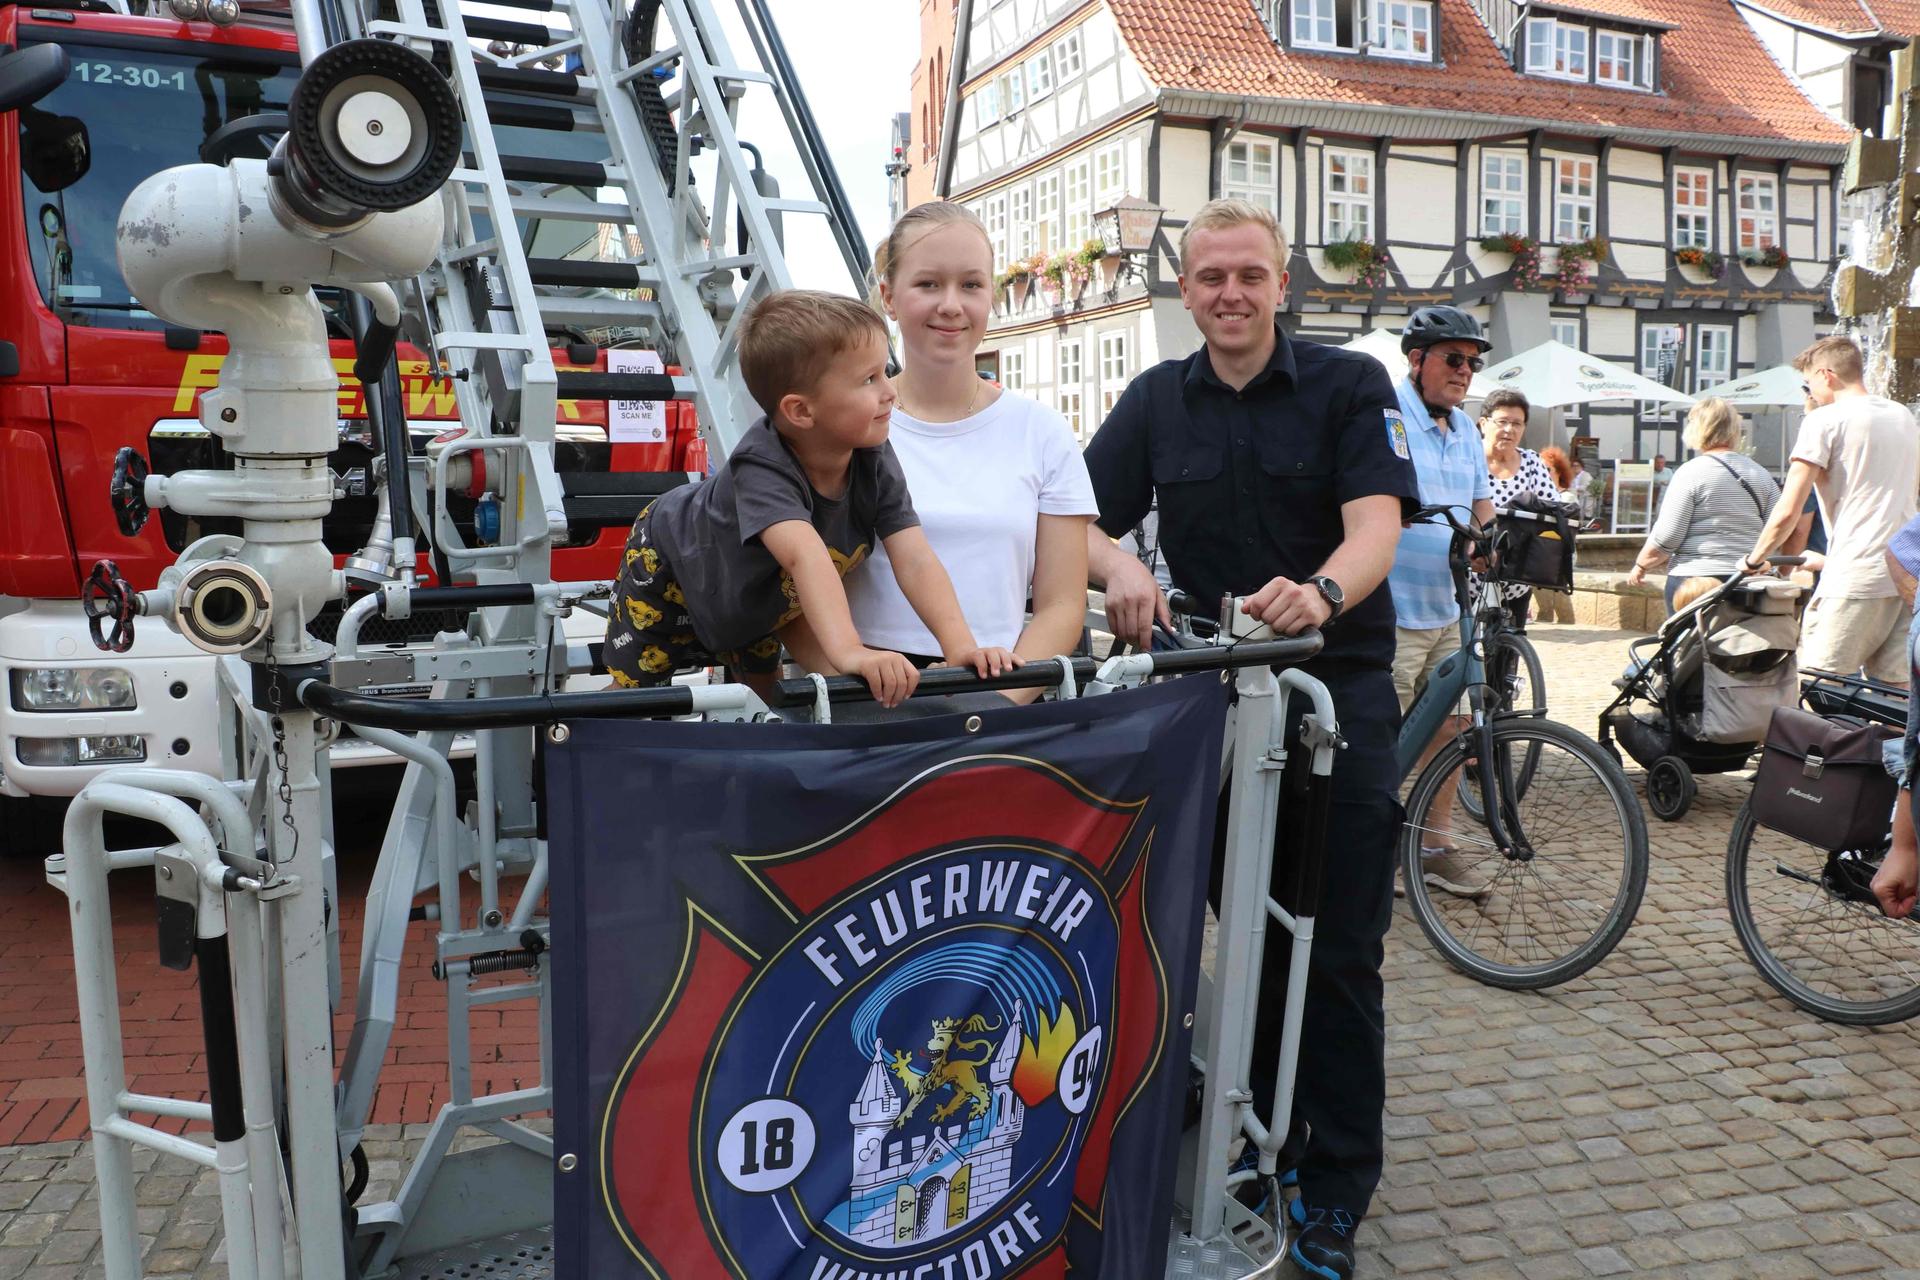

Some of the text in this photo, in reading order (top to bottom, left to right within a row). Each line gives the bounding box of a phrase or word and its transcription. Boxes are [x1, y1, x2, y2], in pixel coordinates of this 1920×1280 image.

[75, 62, 185, 91] 12-30-1
[621, 412, 652, 420] SCAN ME
[740, 1117, 795, 1176] 18
[809, 1201, 1043, 1280] WTORF
